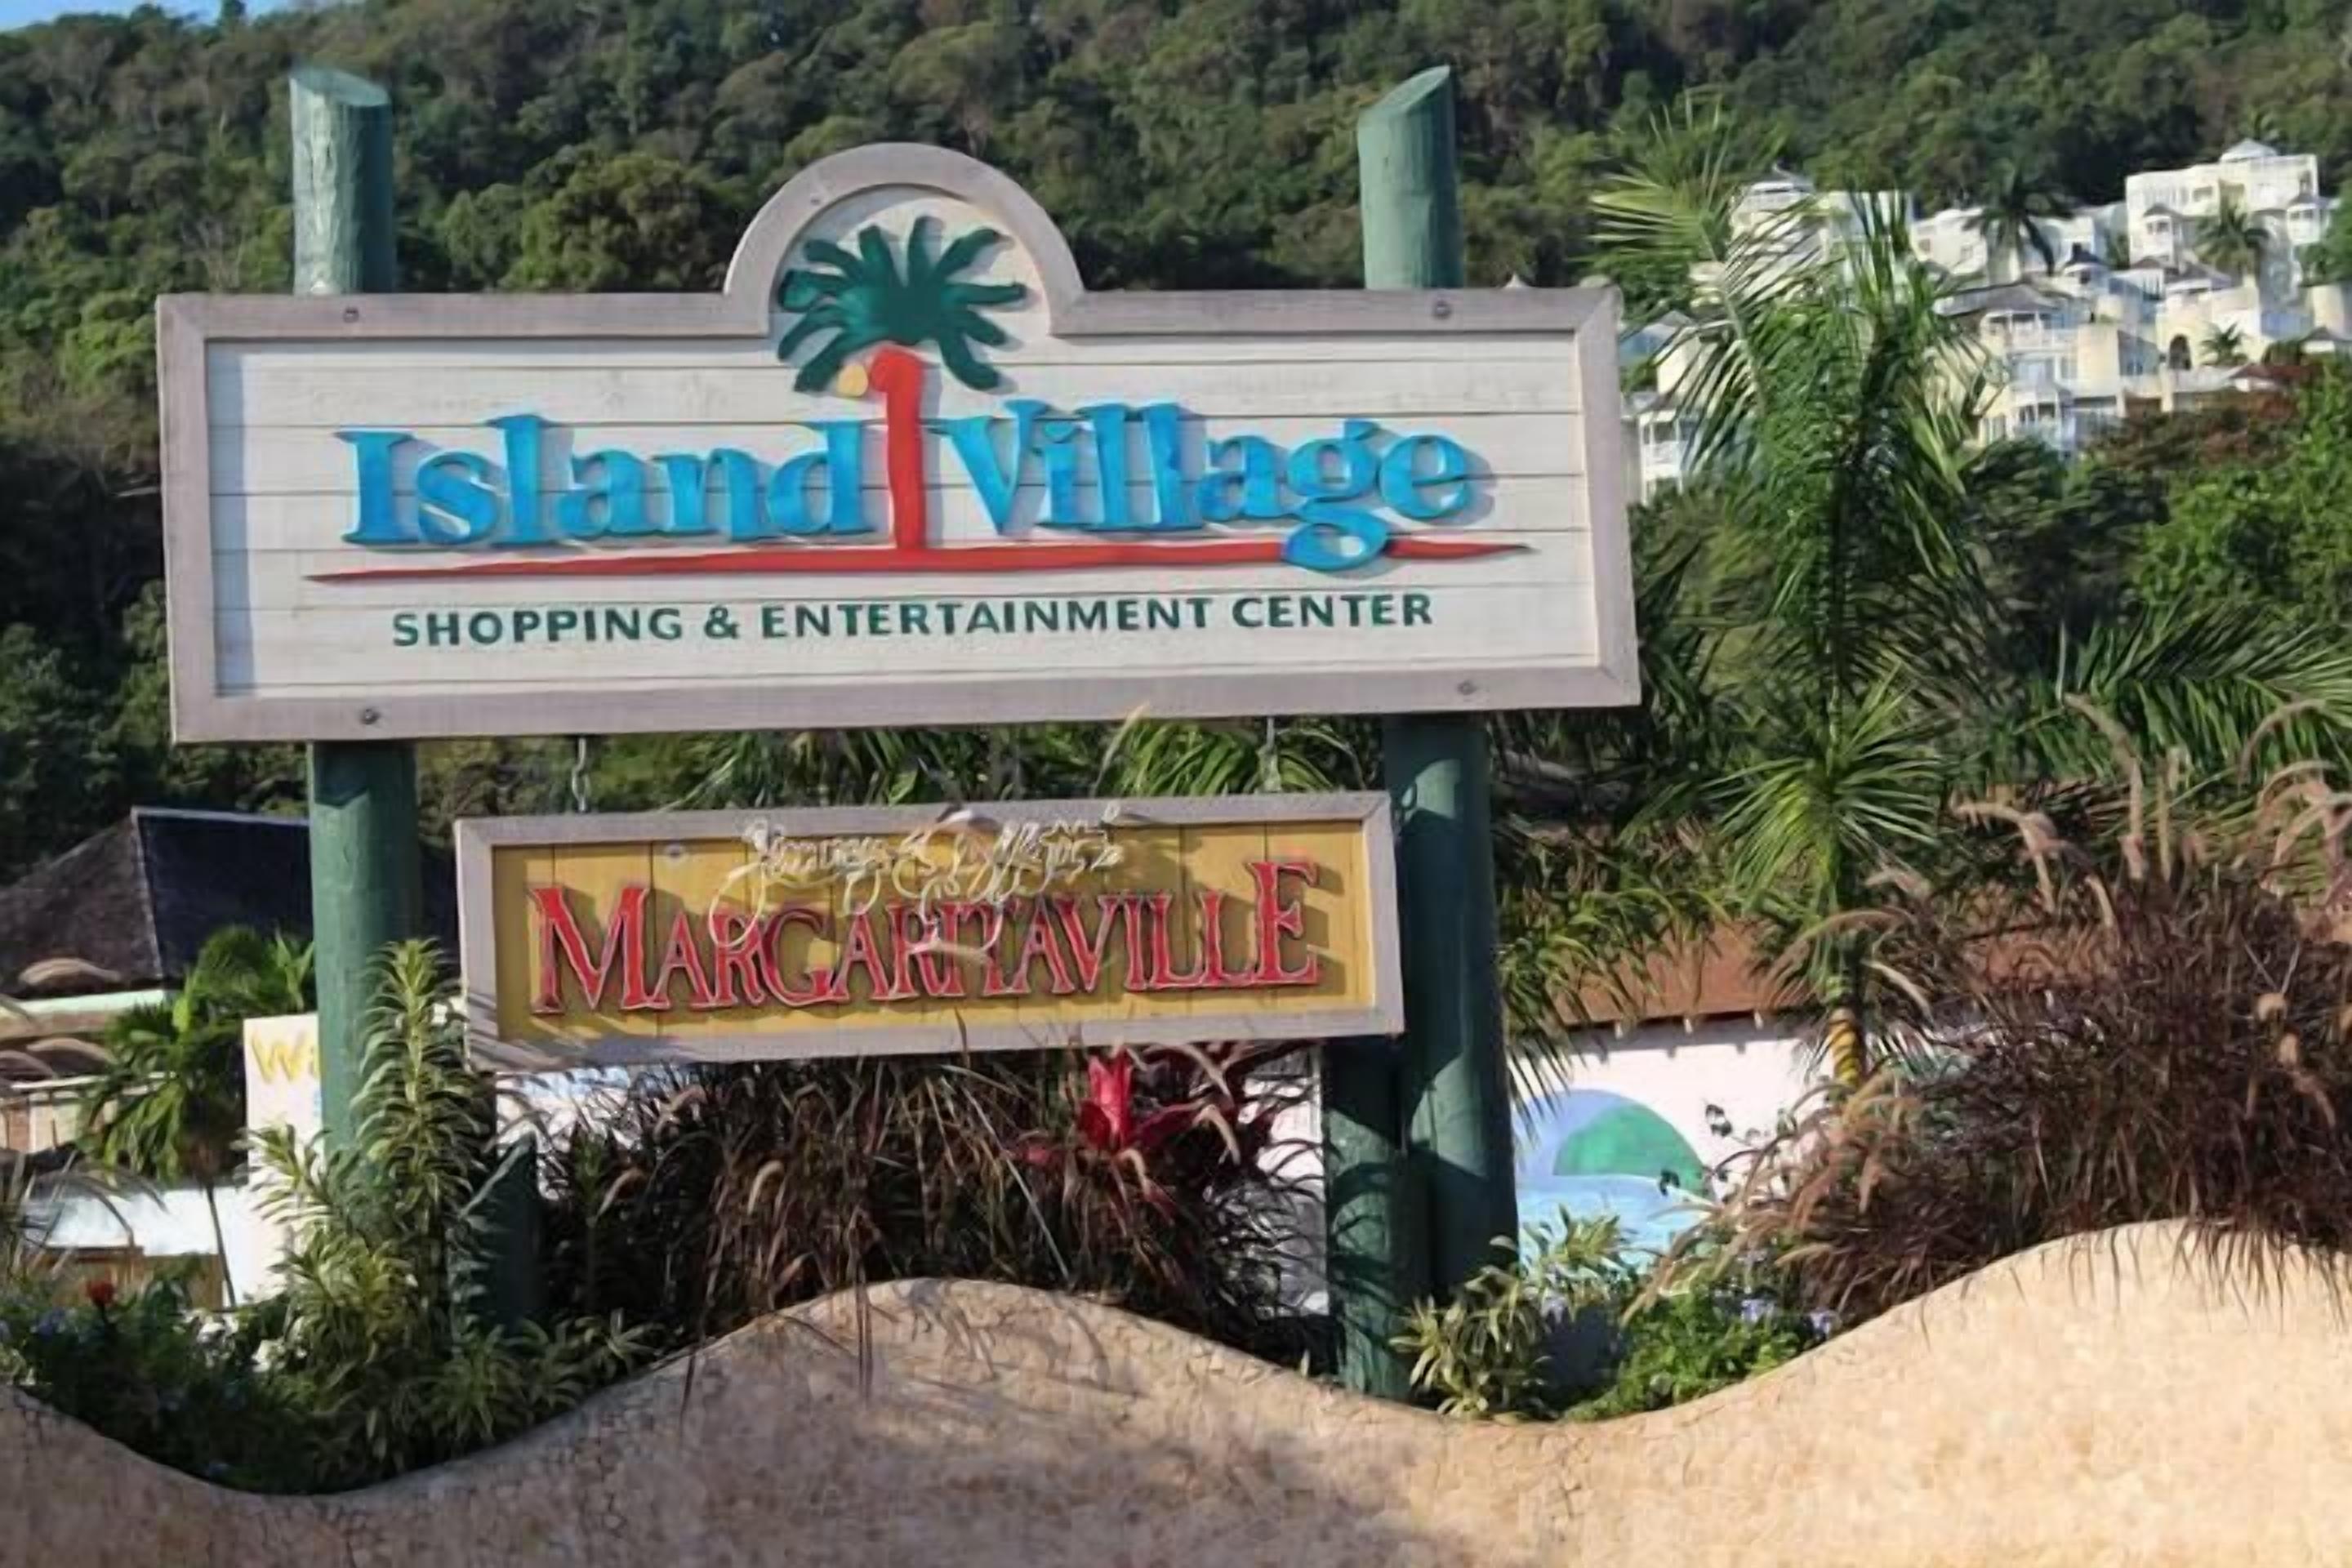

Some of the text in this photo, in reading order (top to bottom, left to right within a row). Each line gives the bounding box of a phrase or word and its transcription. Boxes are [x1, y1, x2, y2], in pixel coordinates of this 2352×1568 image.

[333, 399, 1468, 571] Island Village
[392, 592, 1434, 648] SHOPPING & ENTERTAINMENT CENTER
[527, 862, 1319, 1015] MARGARITAVILLE
